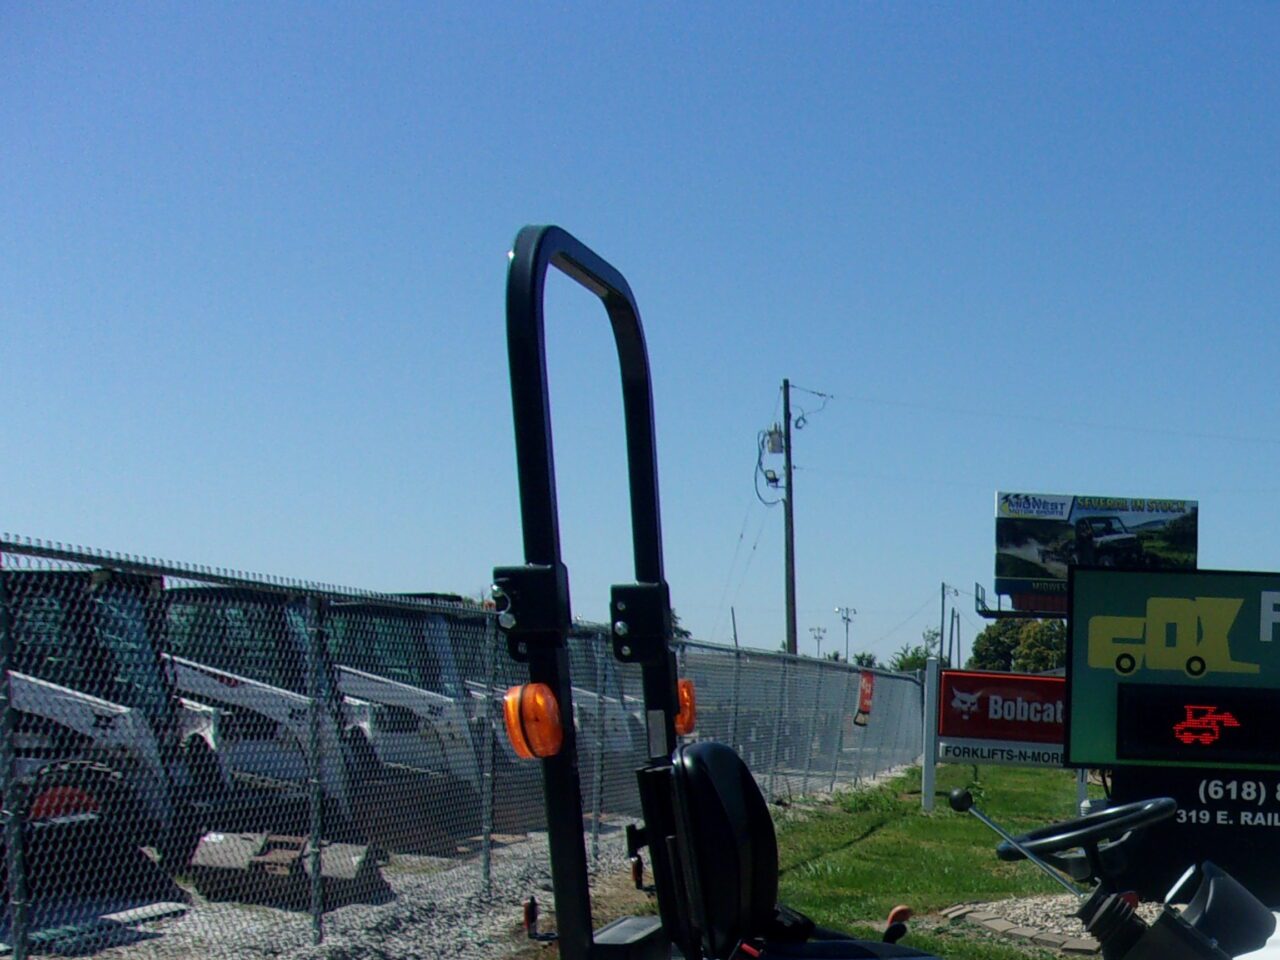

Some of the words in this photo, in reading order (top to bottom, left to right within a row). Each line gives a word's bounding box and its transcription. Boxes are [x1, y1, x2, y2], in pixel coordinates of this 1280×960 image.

[1132, 498, 1145, 512] IN
[988, 694, 1063, 723] Bobcat
[1198, 780, 1266, 806] (618)
[1176, 809, 1210, 824] 319
[1216, 811, 1233, 824] E.
